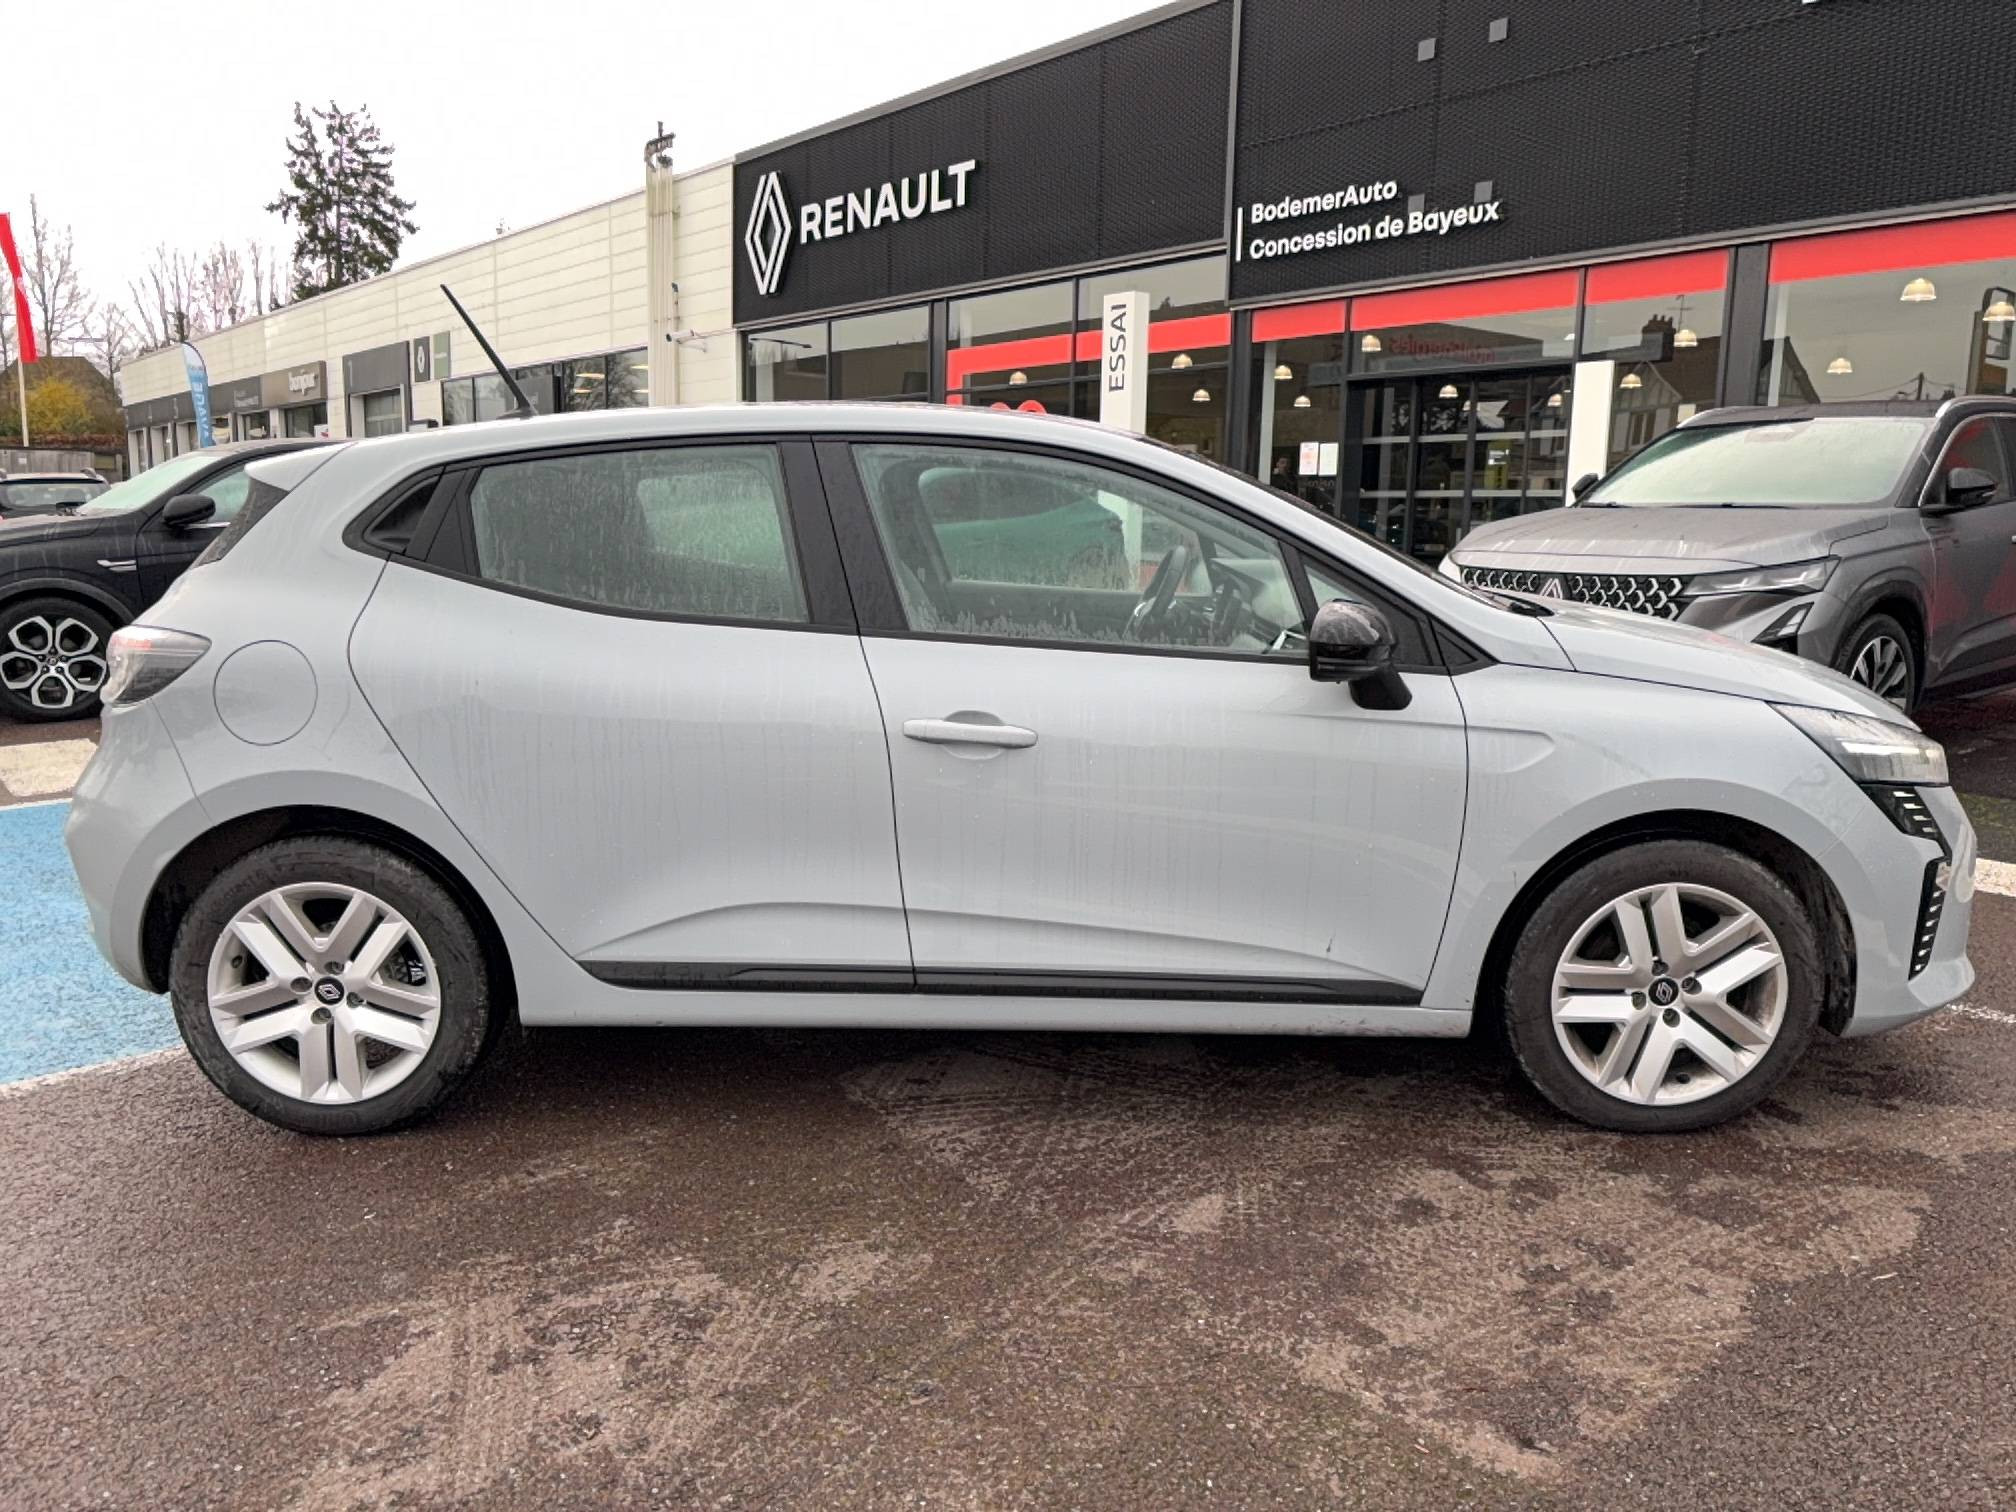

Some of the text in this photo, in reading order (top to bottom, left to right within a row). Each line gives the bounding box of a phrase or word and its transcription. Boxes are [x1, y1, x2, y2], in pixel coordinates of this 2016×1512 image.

[800, 159, 976, 245] RENAULT
[1250, 200, 1500, 260] Concession de Bayeux
[1251, 180, 1398, 224] BodemerAuto
[1108, 303, 1127, 393] ESSAI
